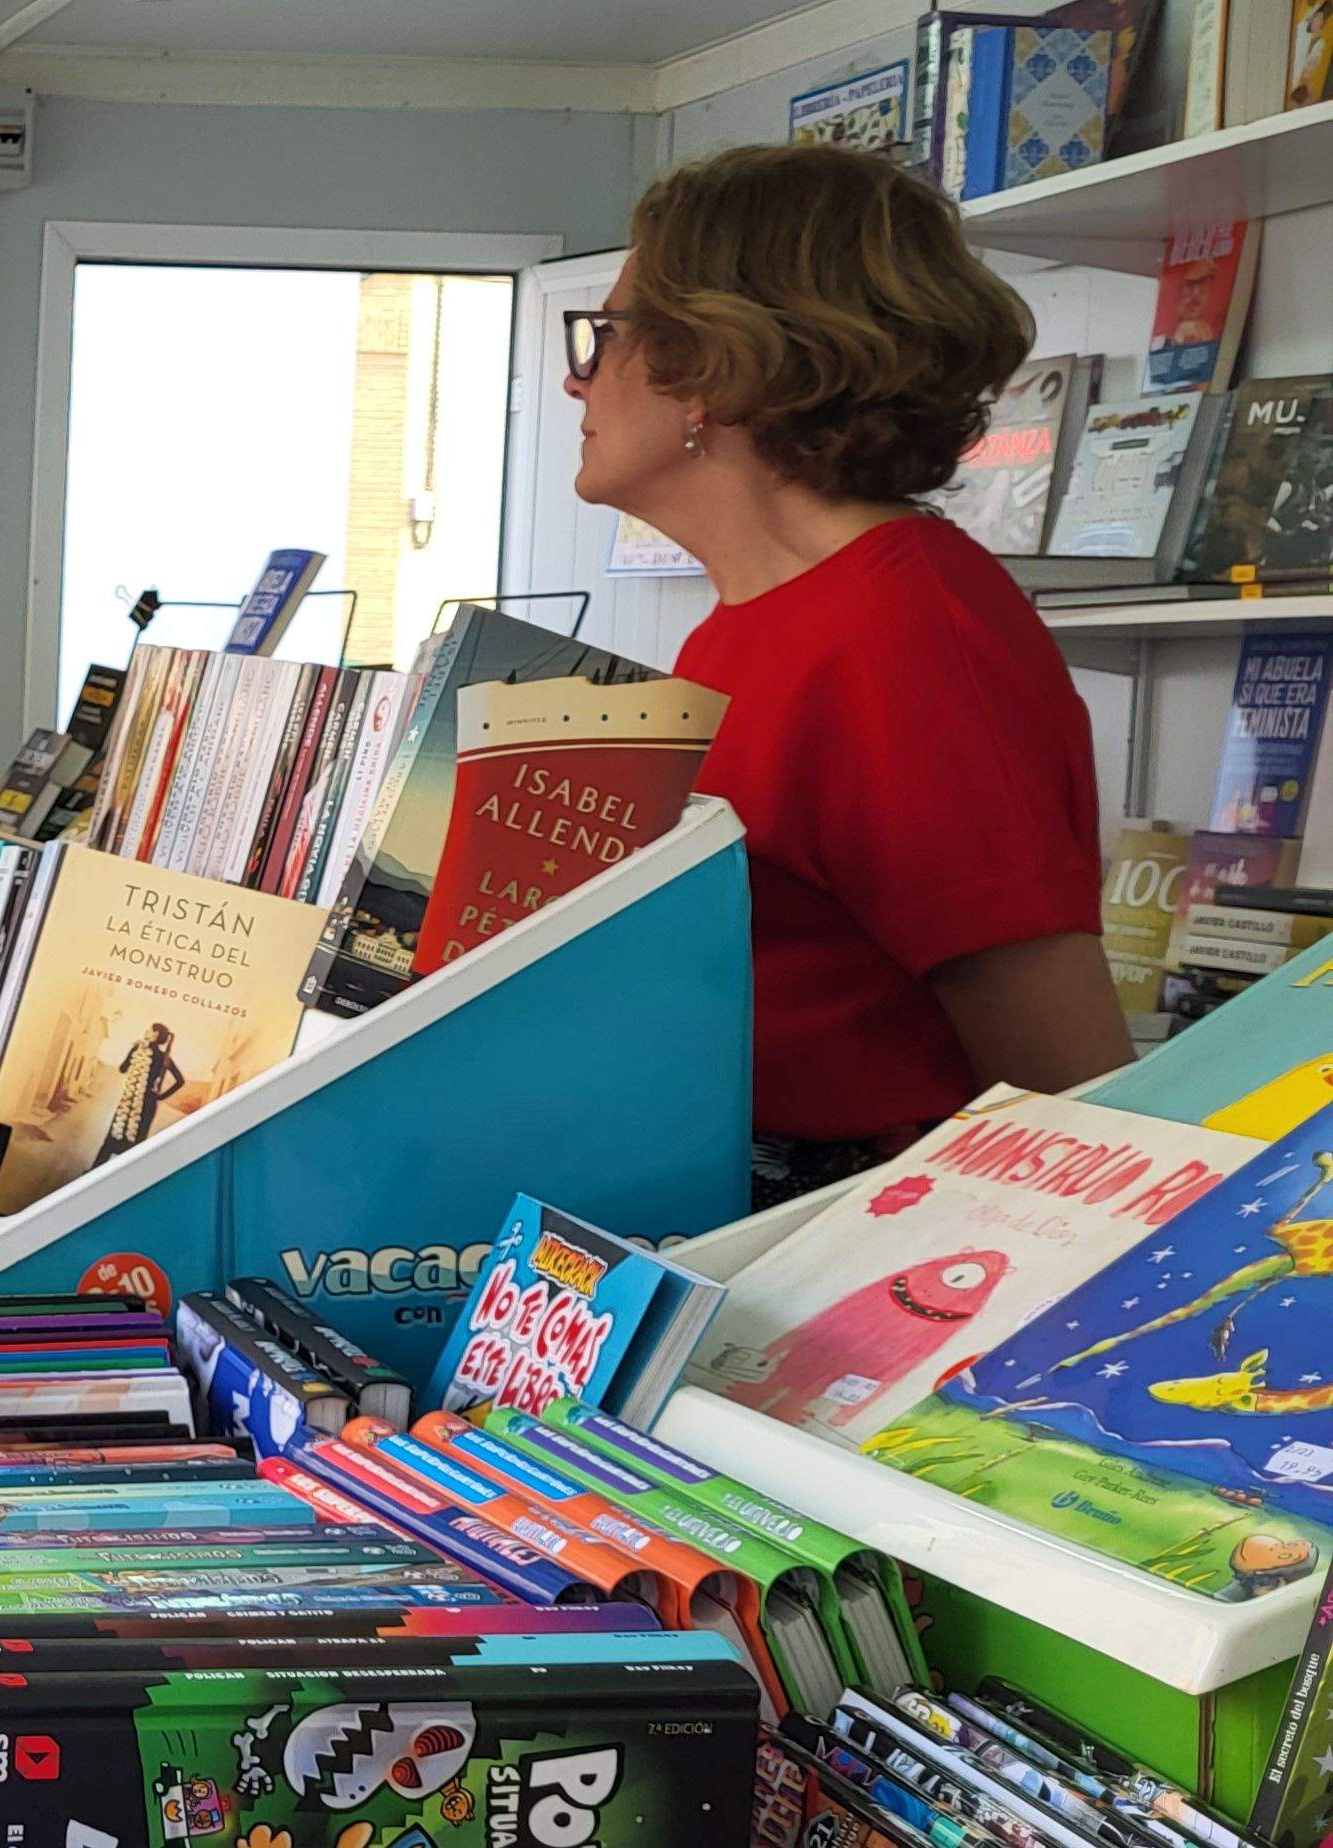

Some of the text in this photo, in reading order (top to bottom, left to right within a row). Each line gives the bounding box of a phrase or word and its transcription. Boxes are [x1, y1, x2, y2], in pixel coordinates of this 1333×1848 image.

[1255, 683, 1285, 704] QUE
[1286, 683, 1316, 705] ERA
[1263, 655, 1323, 681] ABUELA
[302, 682, 328, 748] ALLENDE
[322, 701, 346, 760] CARMEN
[342, 701, 365, 760] CARMEN
[1237, 707, 1310, 739] FEMINISTA
[512, 763, 637, 830] ISABEL
[124, 884, 255, 937] TRISTÁN
[478, 870, 560, 911] LAR
[106, 915, 250, 968] LA ÉTICA DEL
[459, 905, 517, 935] PÉT
[1228, 918, 1274, 933] CASTILLO
[110, 944, 233, 988] MONSTRUO
[1222, 949, 1267, 964] CASTILLO
[81, 966, 247, 1018] JAVIER ROMERO COLLAZOS
[924, 1119, 1225, 1226] MONSTRUO RO
[97, 1262, 119, 1282] de
[279, 1241, 496, 1298] vacac
[394, 1305, 443, 1329] con
[471, 1258, 614, 1391] NO TE COMAS
[456, 1332, 512, 1392] ESTE
[185, 1671, 245, 1679] POLICAN
[664, 1721, 713, 1735] EDICIÓN
[1269, 1653, 1320, 1785] El secreto del bosque
[489, 1765, 521, 1848] SITUA
[528, 1747, 619, 1848] PO
